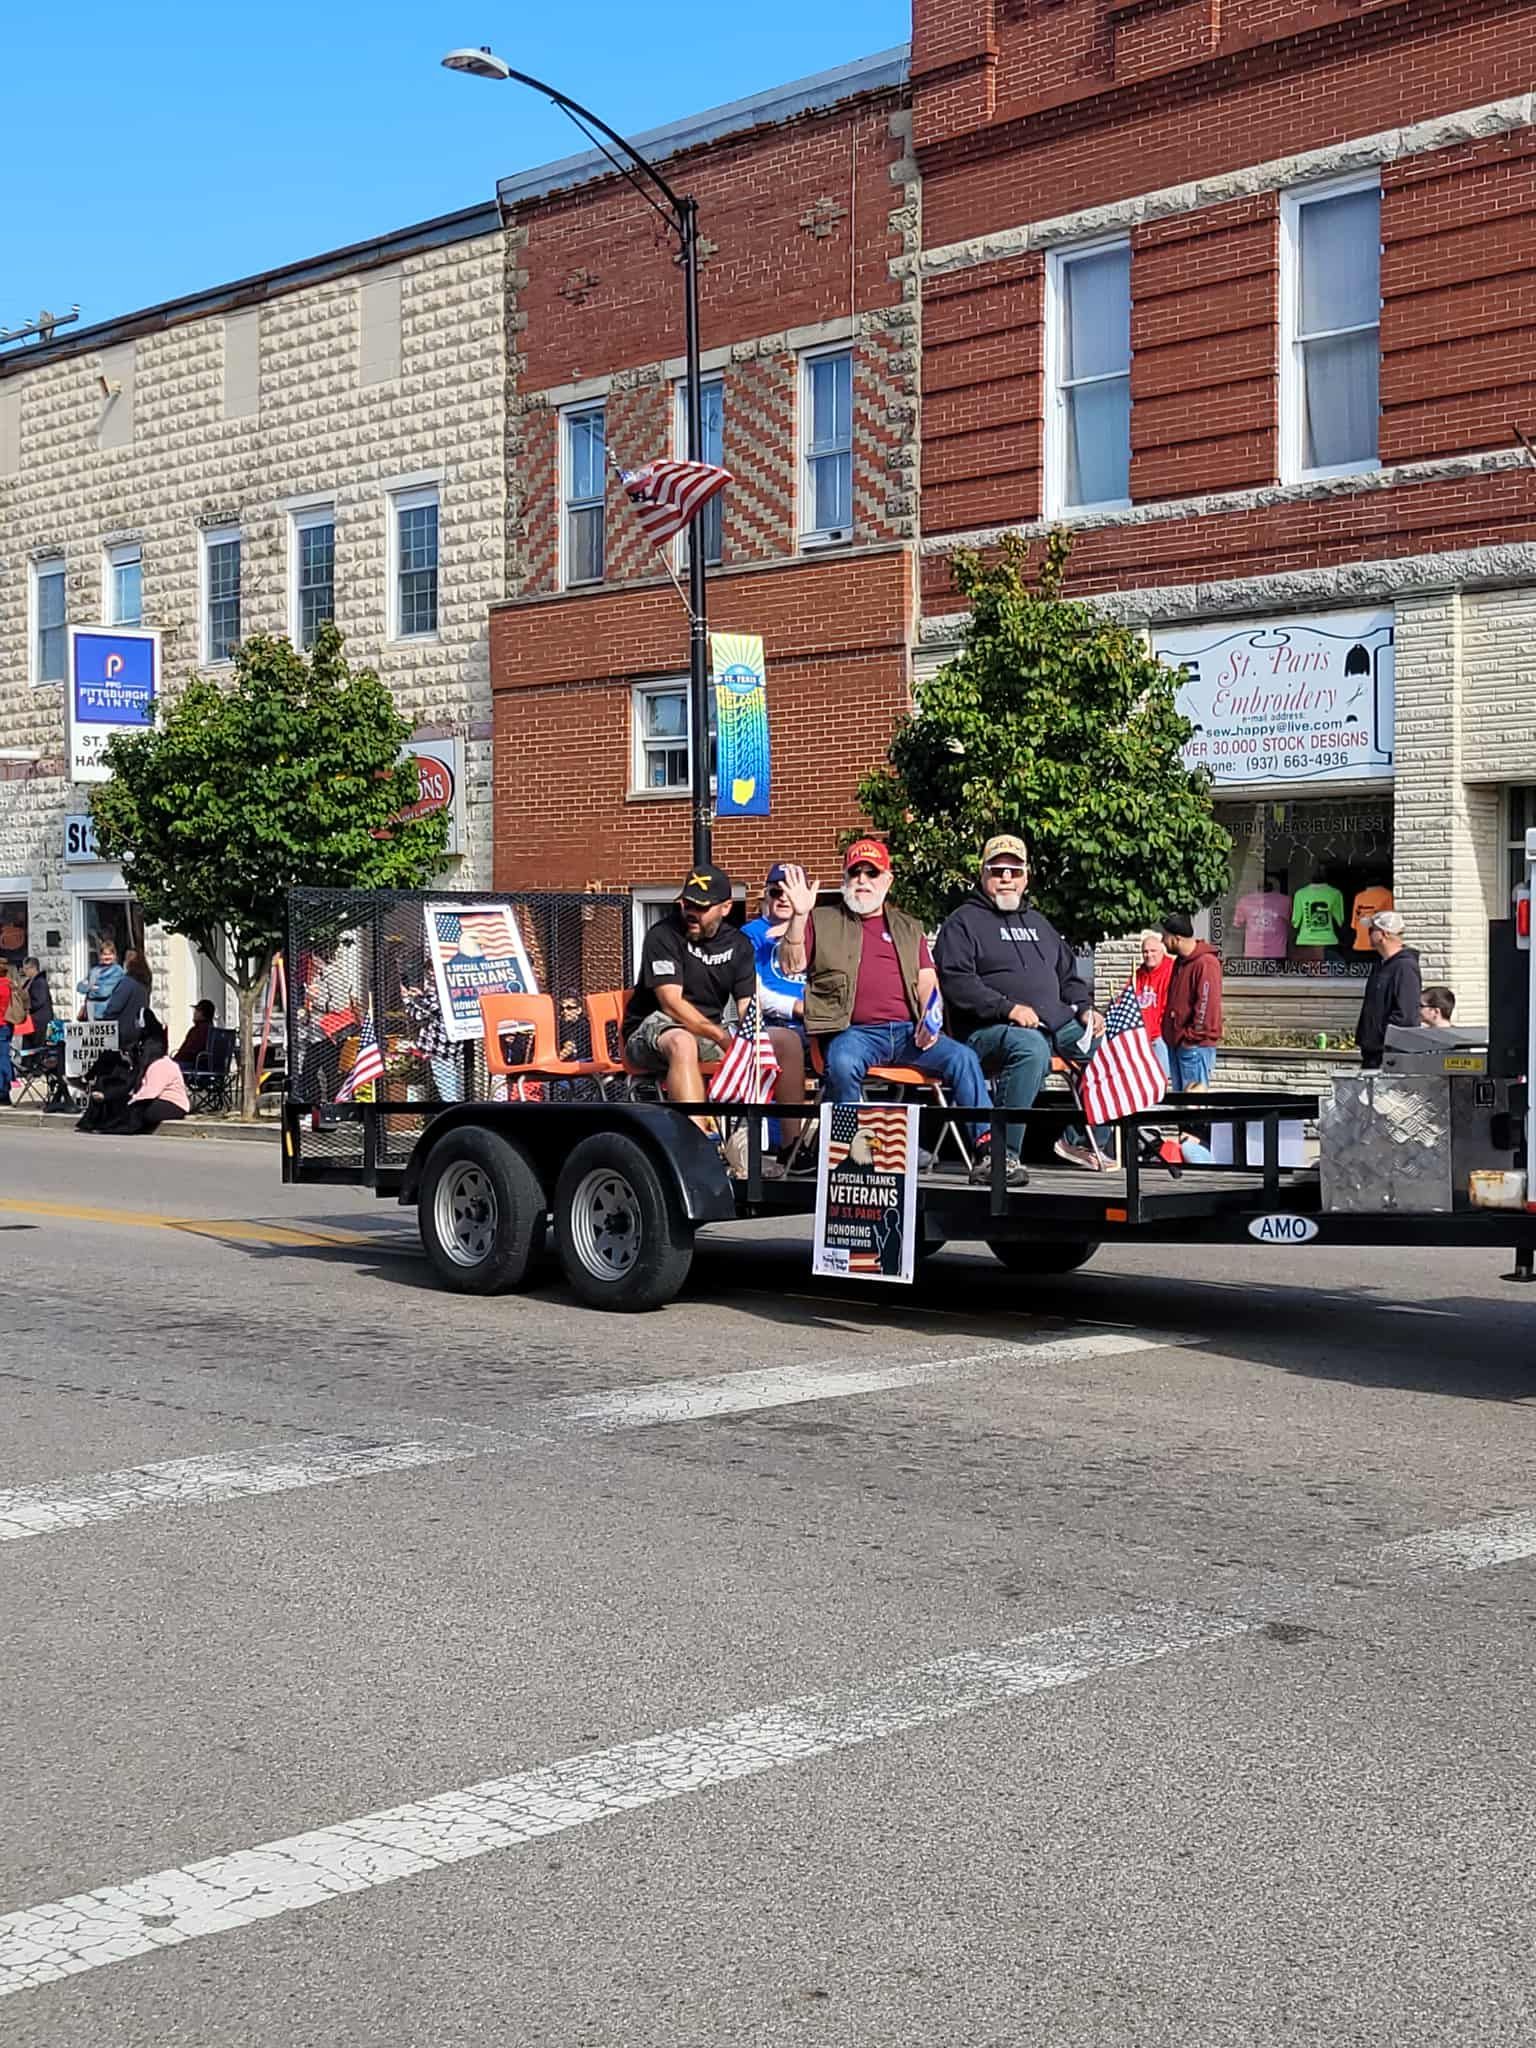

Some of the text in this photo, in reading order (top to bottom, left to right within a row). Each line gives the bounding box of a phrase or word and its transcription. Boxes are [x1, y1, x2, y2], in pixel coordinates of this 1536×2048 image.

[1217, 643, 1331, 688] St. Paris
[80, 688, 149, 700] PITTSBURGH
[1212, 682, 1337, 718] Embroidery
[1242, 714, 1267, 723] e-mail
[1206, 718, 1343, 738] sew_happy@live.com
[1213, 739, 1257, 756] 30,000
[1263, 735, 1305, 753] STOCK
[1311, 731, 1369, 749] DESIGNS
[1196, 752, 1349, 773] Phone: (937) 663-4936
[1226, 820, 1265, 834] SPIRIT
[1000, 927, 1040, 941] ARMY
[446, 968, 517, 987] VETERANS
[89, 1025, 116, 1036] HOSES
[82, 1038, 105, 1047] MADE
[73, 1050, 99, 1060] REPAI
[837, 1173, 865, 1185] SPECIAL
[866, 1174, 897, 1186] THANKS
[830, 1185, 898, 1207] VETERANS
[855, 1208, 882, 1220] PARIS
[827, 1224, 871, 1238] HONORING
[1260, 1217, 1307, 1239] AMO
